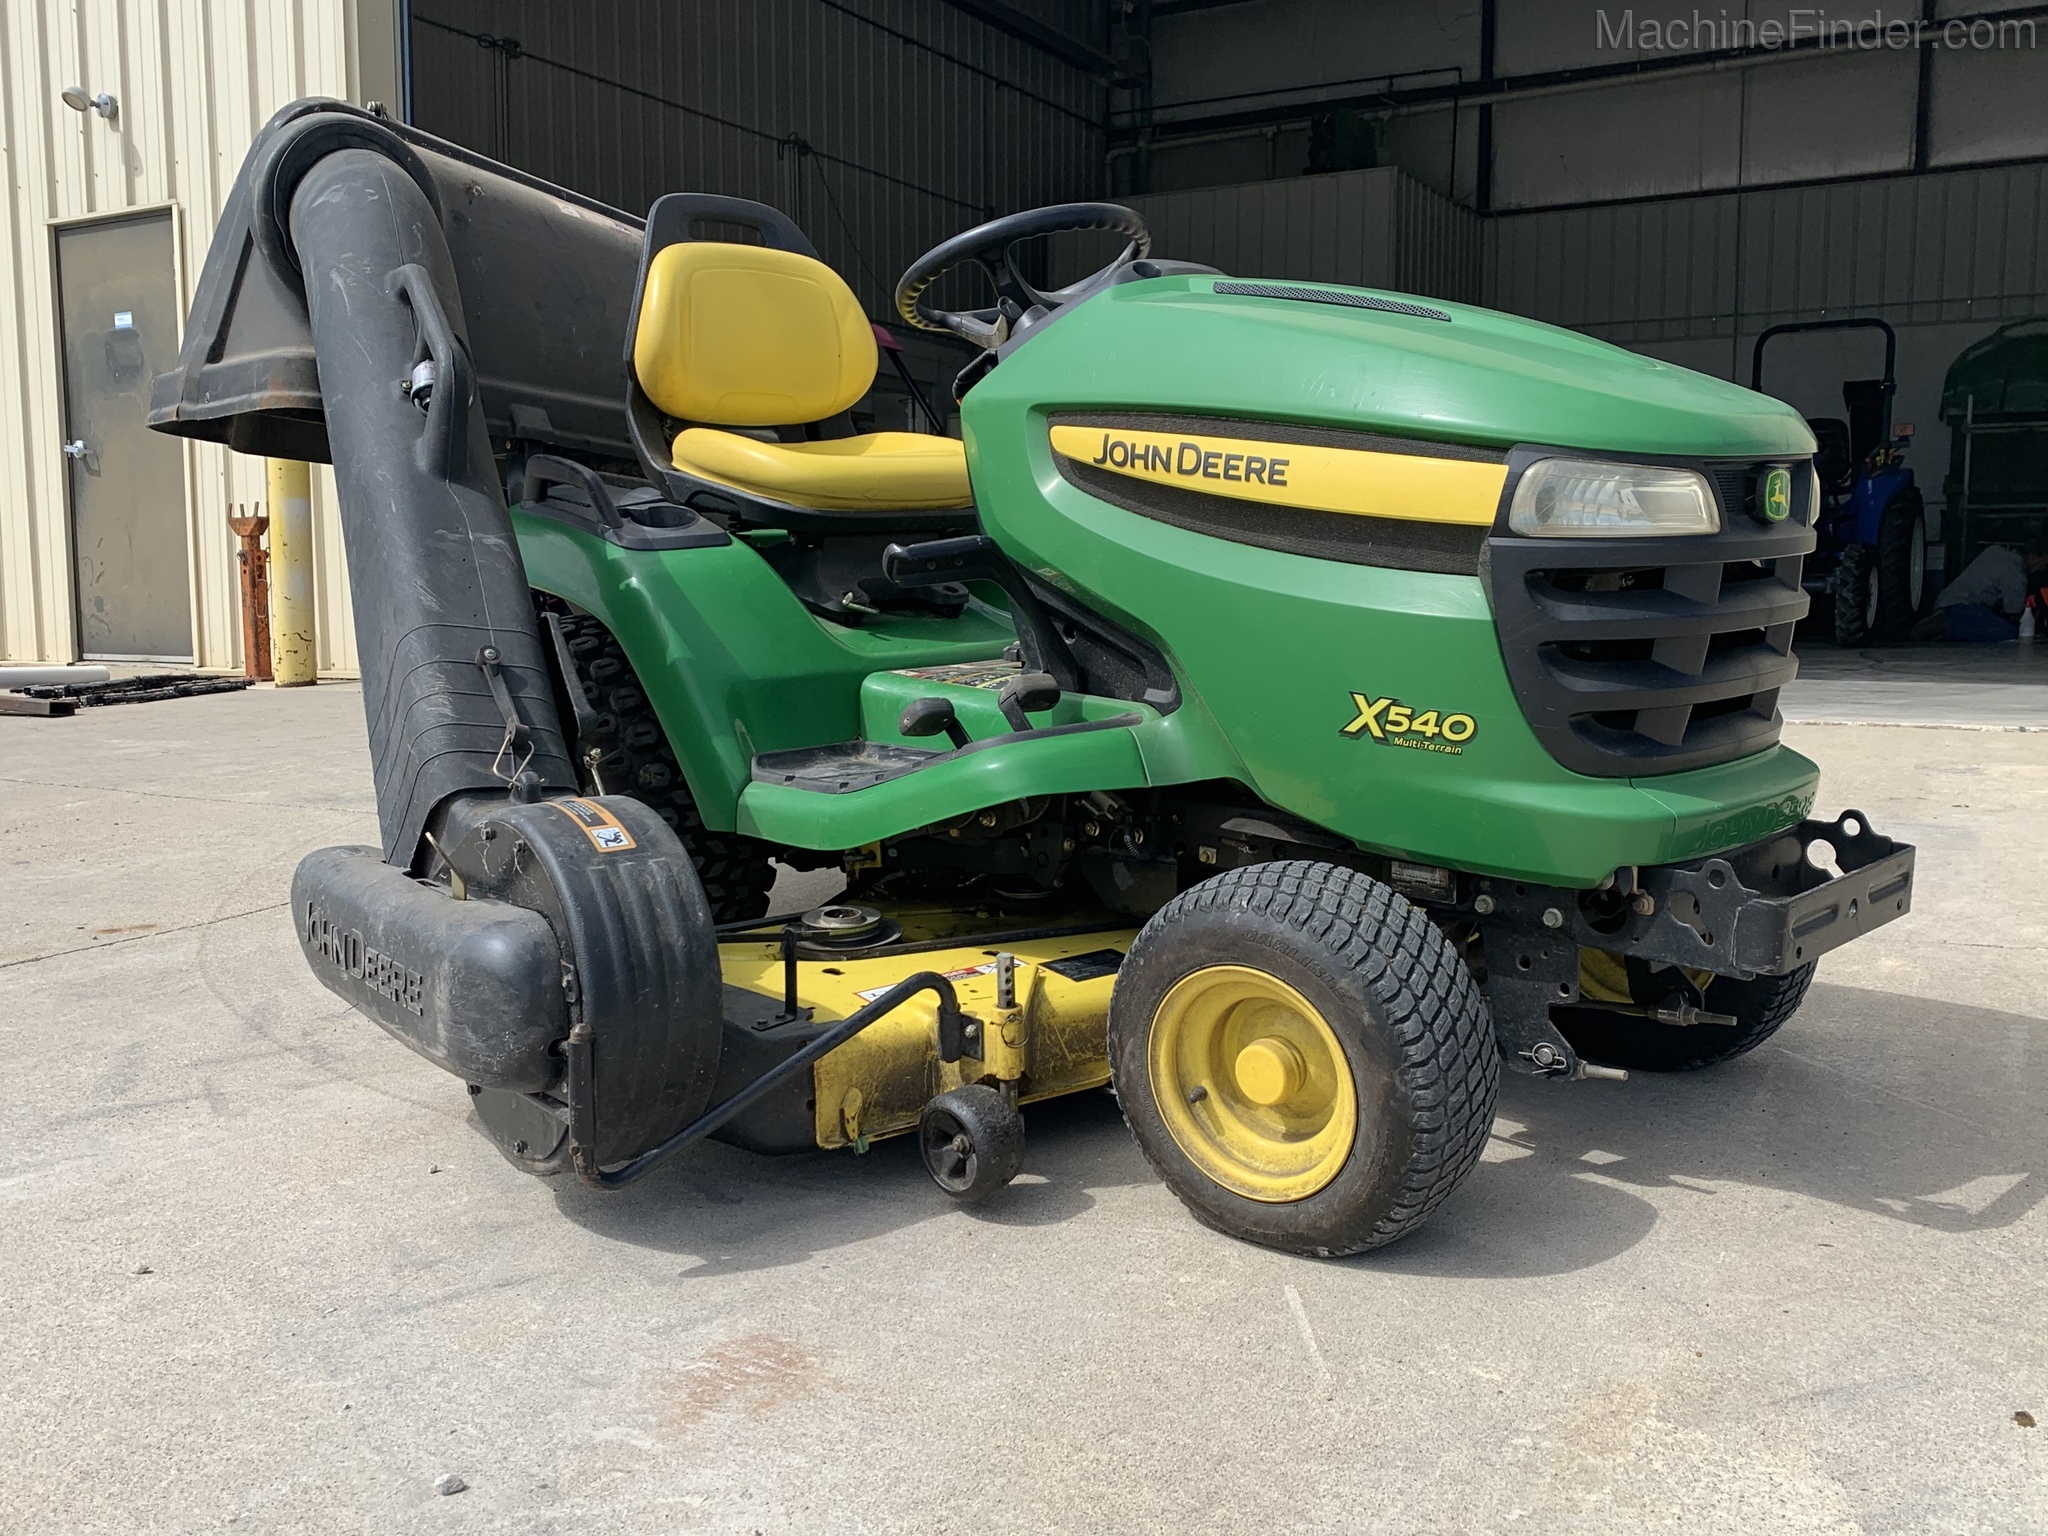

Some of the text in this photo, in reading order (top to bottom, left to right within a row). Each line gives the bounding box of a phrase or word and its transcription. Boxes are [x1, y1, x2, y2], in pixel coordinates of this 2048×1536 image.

[1093, 433, 1290, 486] JOHN DEERE
[1339, 691, 1477, 743] X540
[1394, 737, 1462, 755] Multi-Terrain
[302, 900, 423, 1016] JOHN DEERE
[1242, 929, 1346, 1003] CARLISLE
